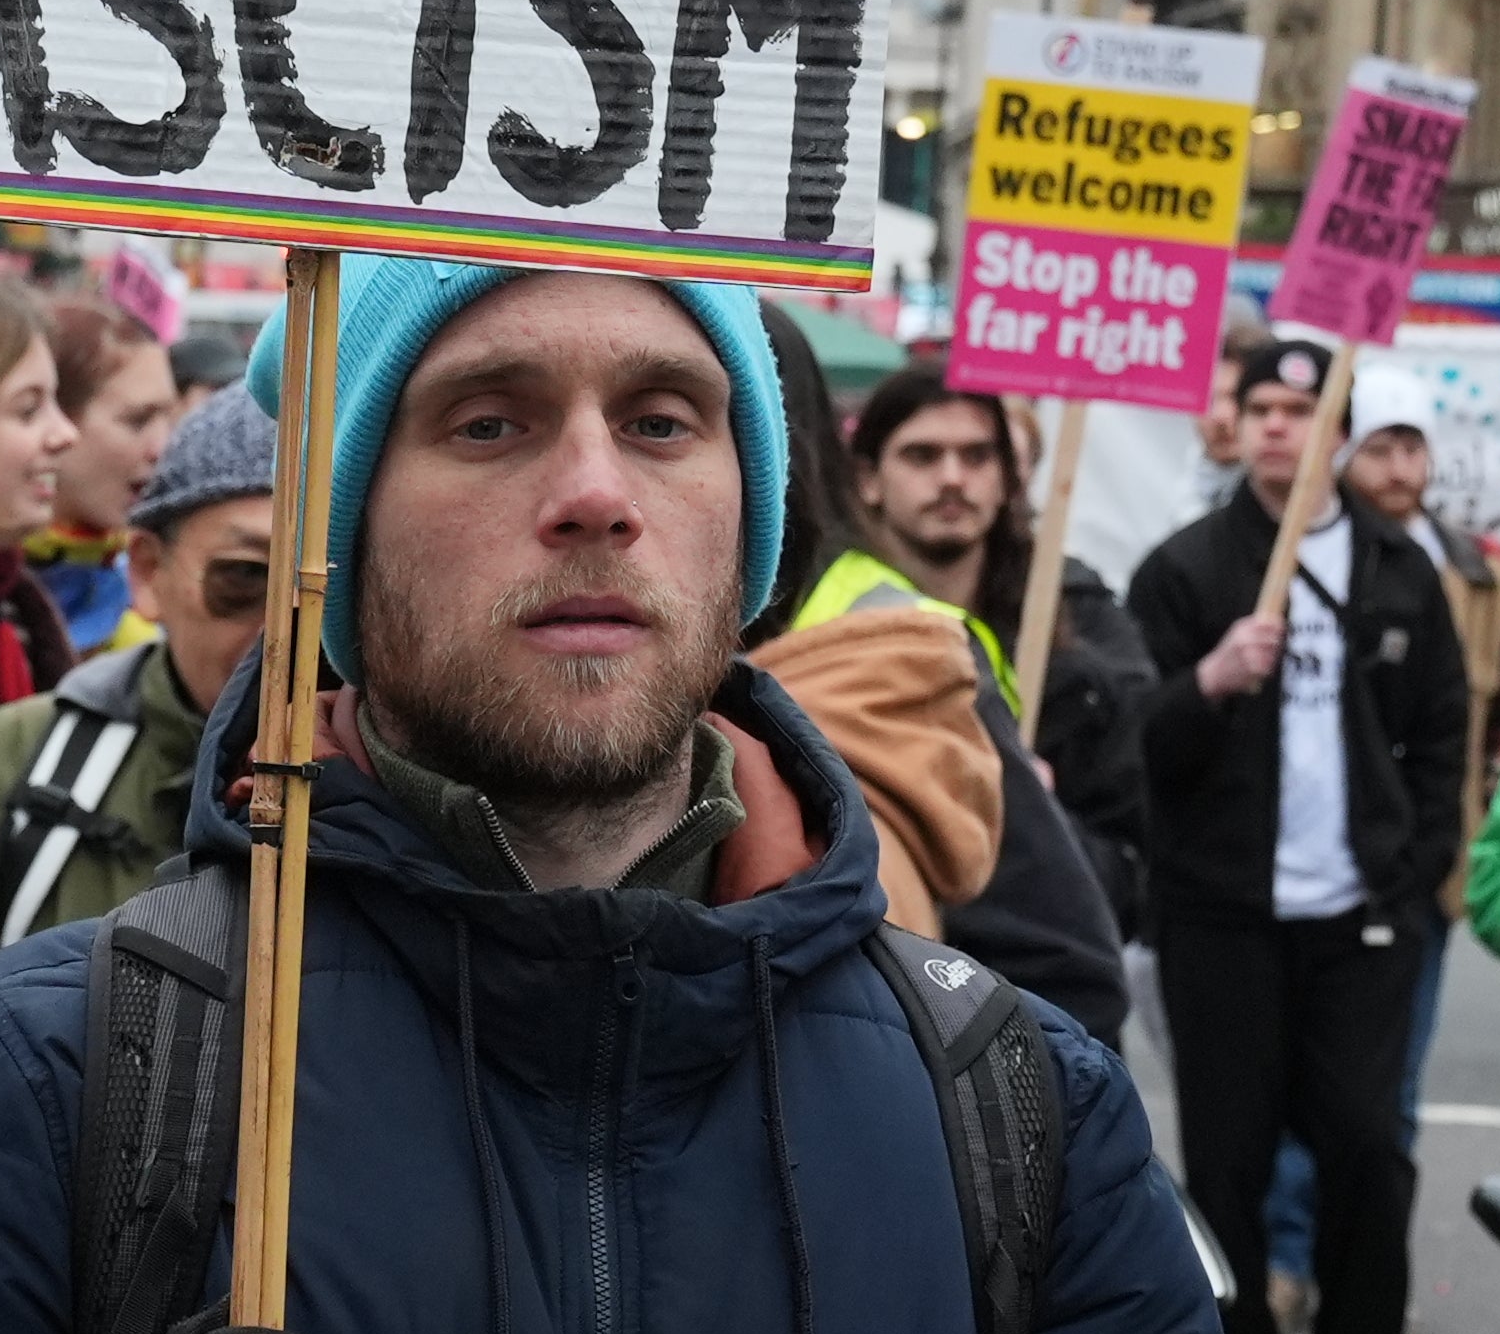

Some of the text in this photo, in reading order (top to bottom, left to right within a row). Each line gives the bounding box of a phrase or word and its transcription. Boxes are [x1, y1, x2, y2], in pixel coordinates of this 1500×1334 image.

[996, 90, 1234, 164] Refugees
[989, 158, 1214, 221] welcome
[974, 229, 1198, 310] Stop the
[966, 292, 1187, 374] far right
